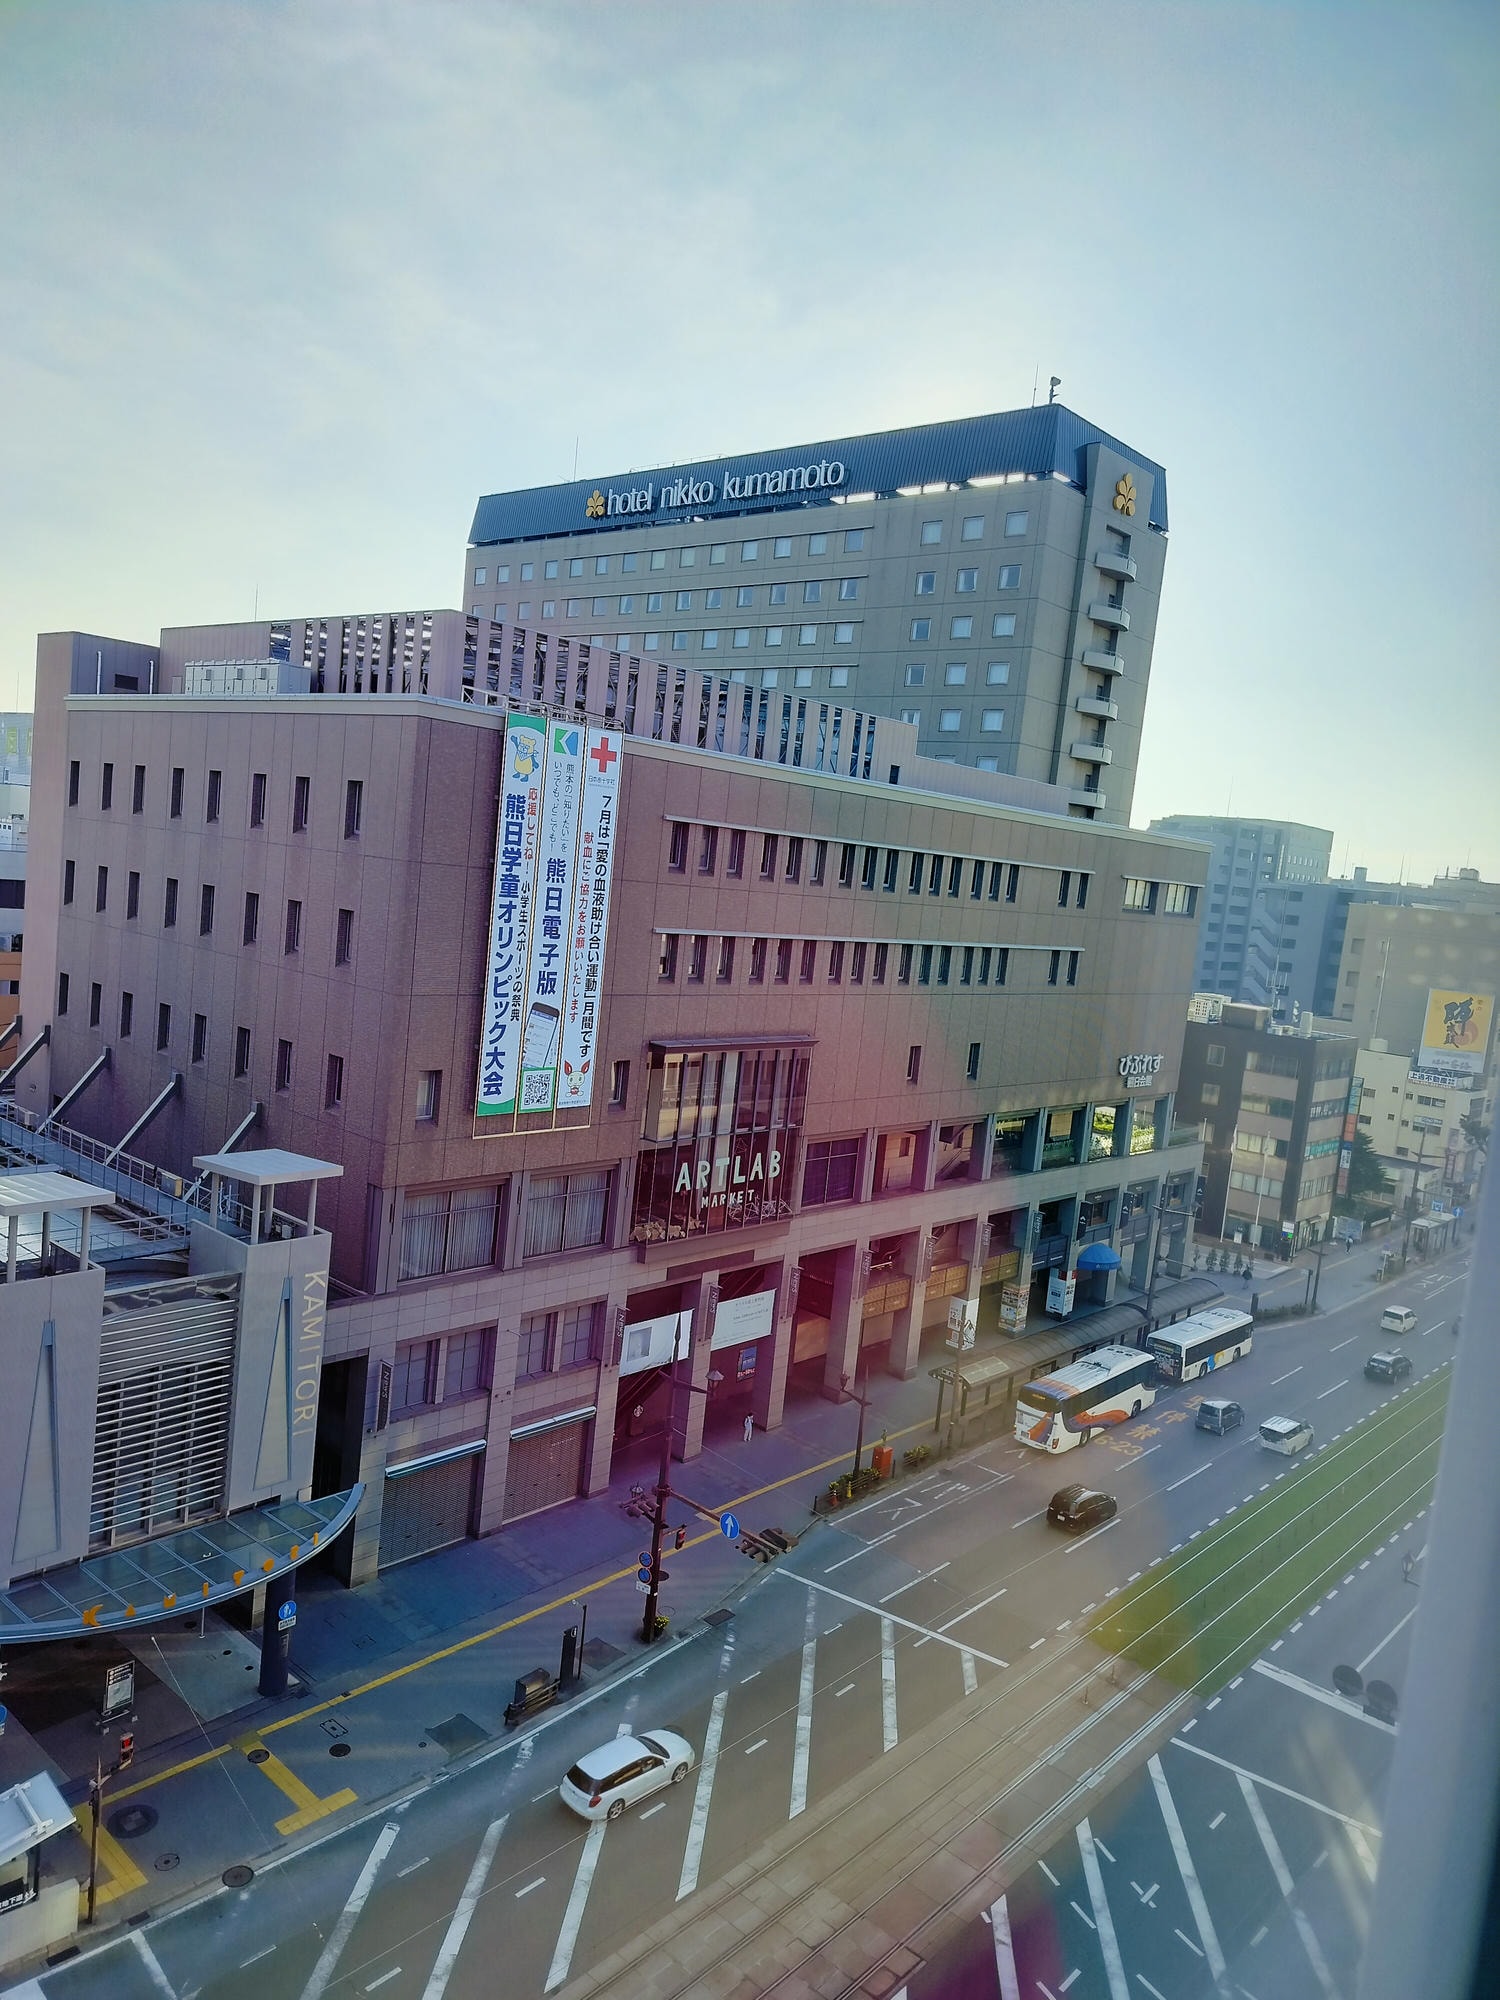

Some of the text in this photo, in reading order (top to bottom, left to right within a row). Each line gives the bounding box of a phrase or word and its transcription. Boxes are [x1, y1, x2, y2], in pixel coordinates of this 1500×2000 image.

[606, 459, 845, 516] hotel nikko kumamoto
[482, 793, 527, 1097] 熊日学童オリンピック大会
[536, 858, 568, 996] 熊日電子版
[568, 831, 594, 1023] 献血にご協力をお願いいたします
[675, 1150, 782, 1193] ARTLAB
[701, 1189, 755, 1209] MARKET
[292, 1270, 328, 1437] KAMITORI
